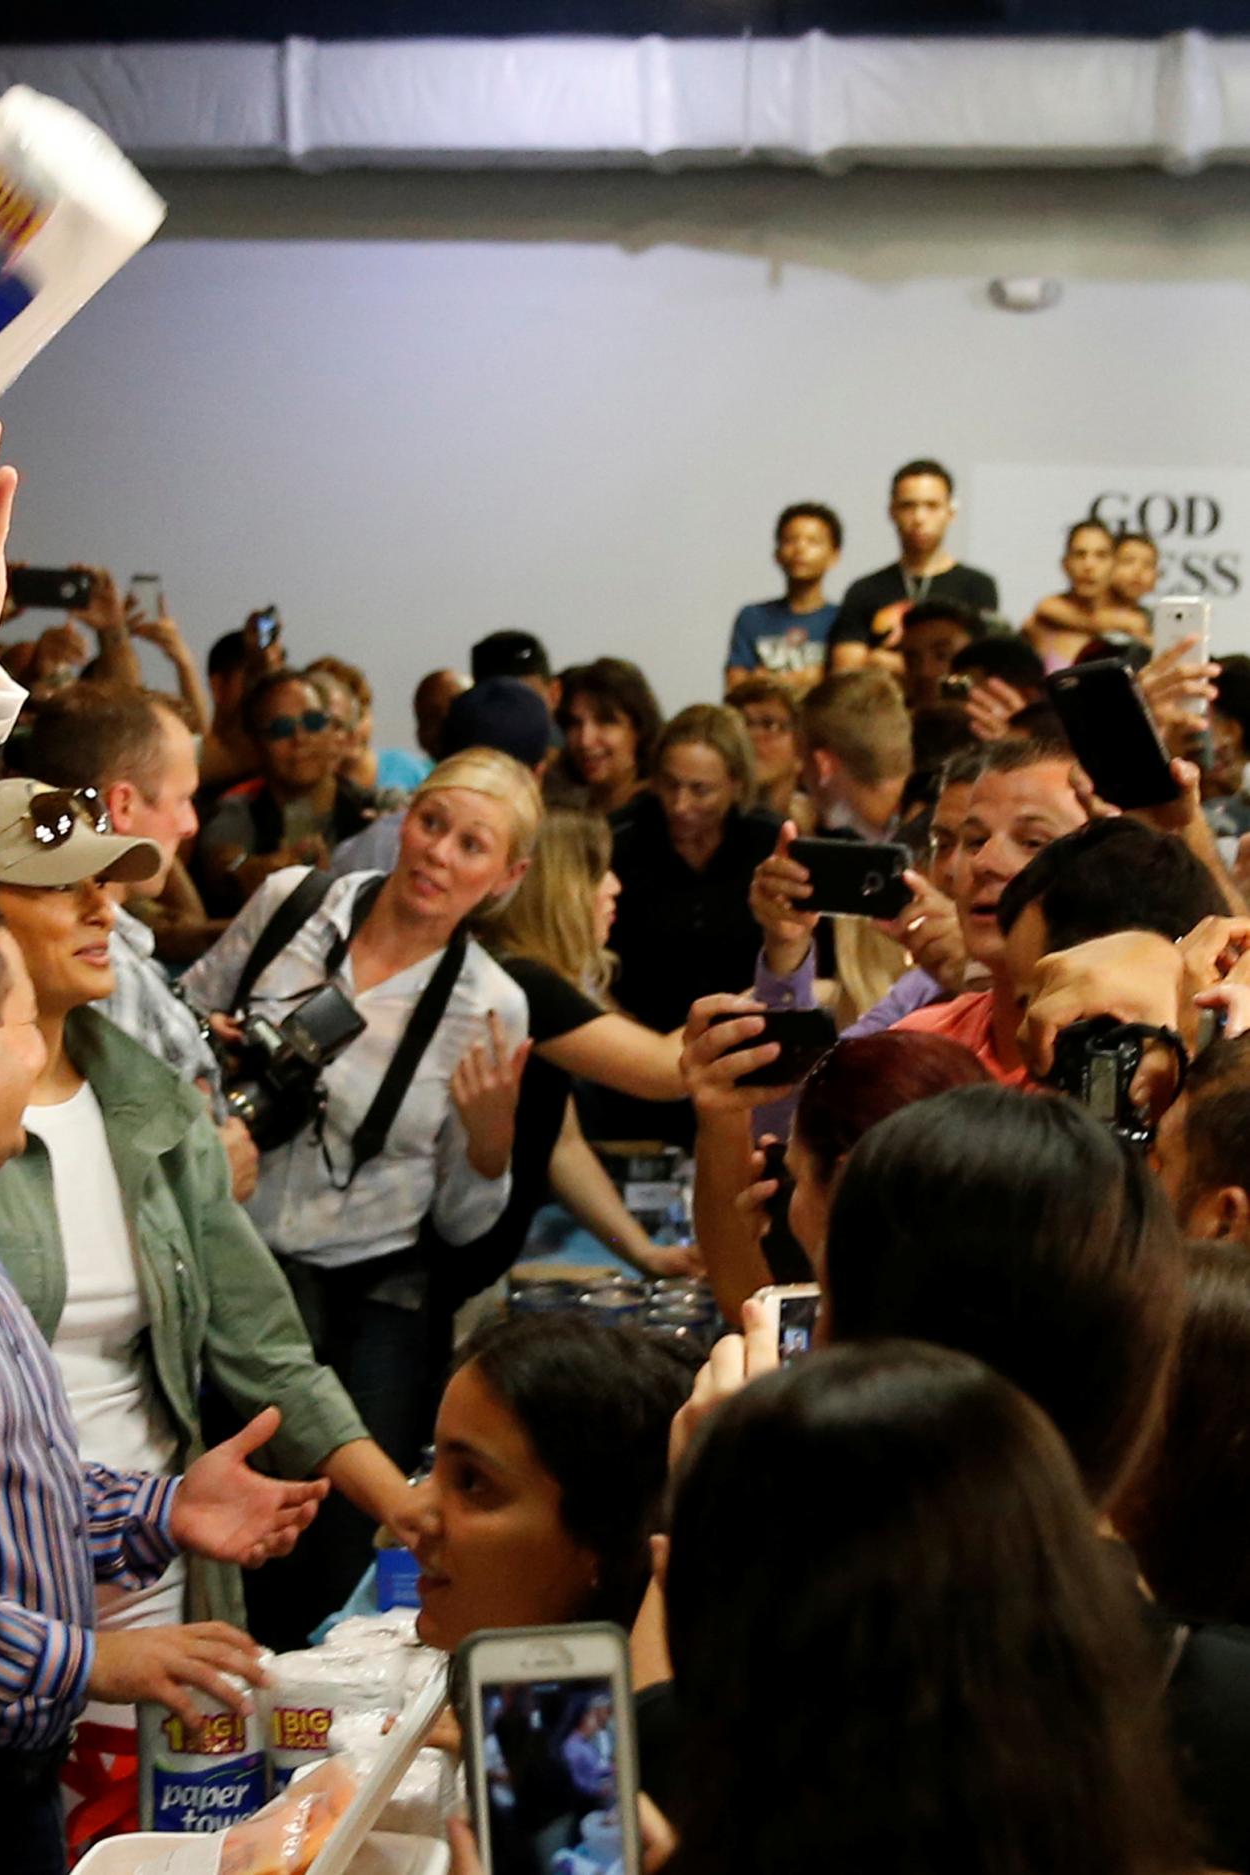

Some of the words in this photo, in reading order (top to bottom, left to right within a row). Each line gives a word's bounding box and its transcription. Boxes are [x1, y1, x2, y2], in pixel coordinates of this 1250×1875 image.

[1087, 491, 1222, 537] GOD
[285, 1710, 330, 1734] BIG
[160, 1782, 251, 1811] paper
